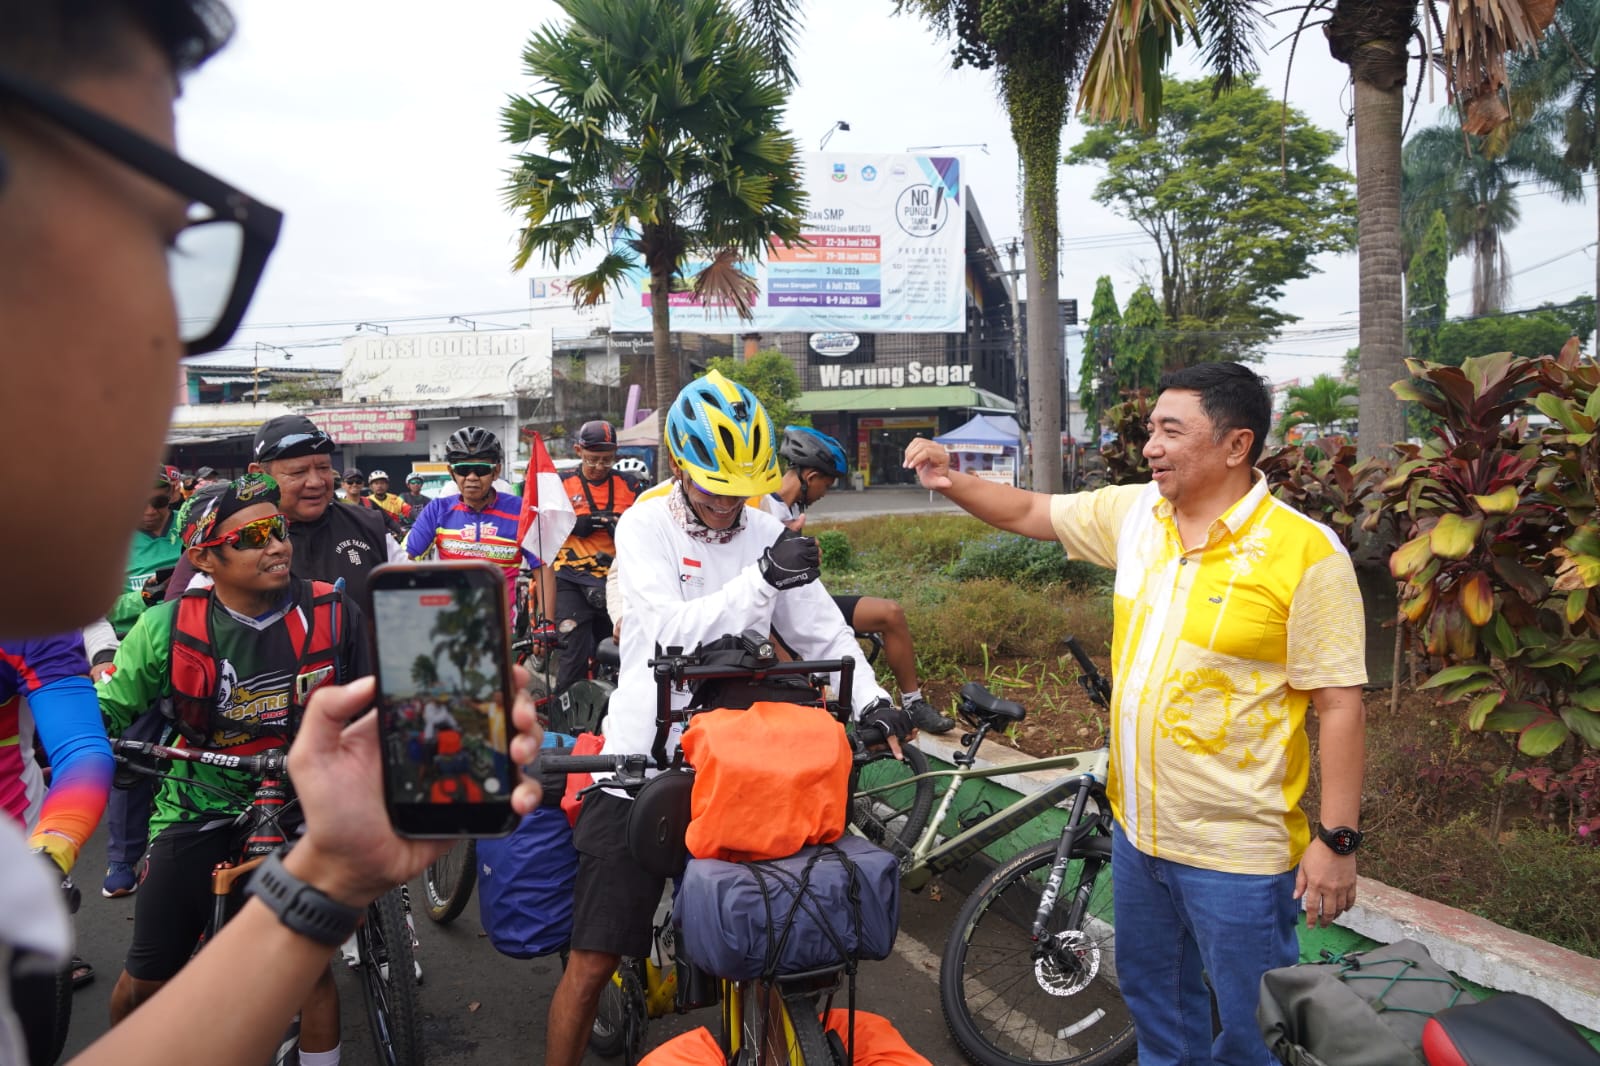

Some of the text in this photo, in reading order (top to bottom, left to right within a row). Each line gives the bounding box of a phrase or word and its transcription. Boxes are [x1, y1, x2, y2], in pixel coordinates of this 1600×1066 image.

[911, 189, 929, 206] NO
[823, 208, 845, 220] SMP
[904, 206, 932, 216] PUNGLI
[367, 338, 421, 361] NASI
[819, 361, 974, 387] Warung Segar
